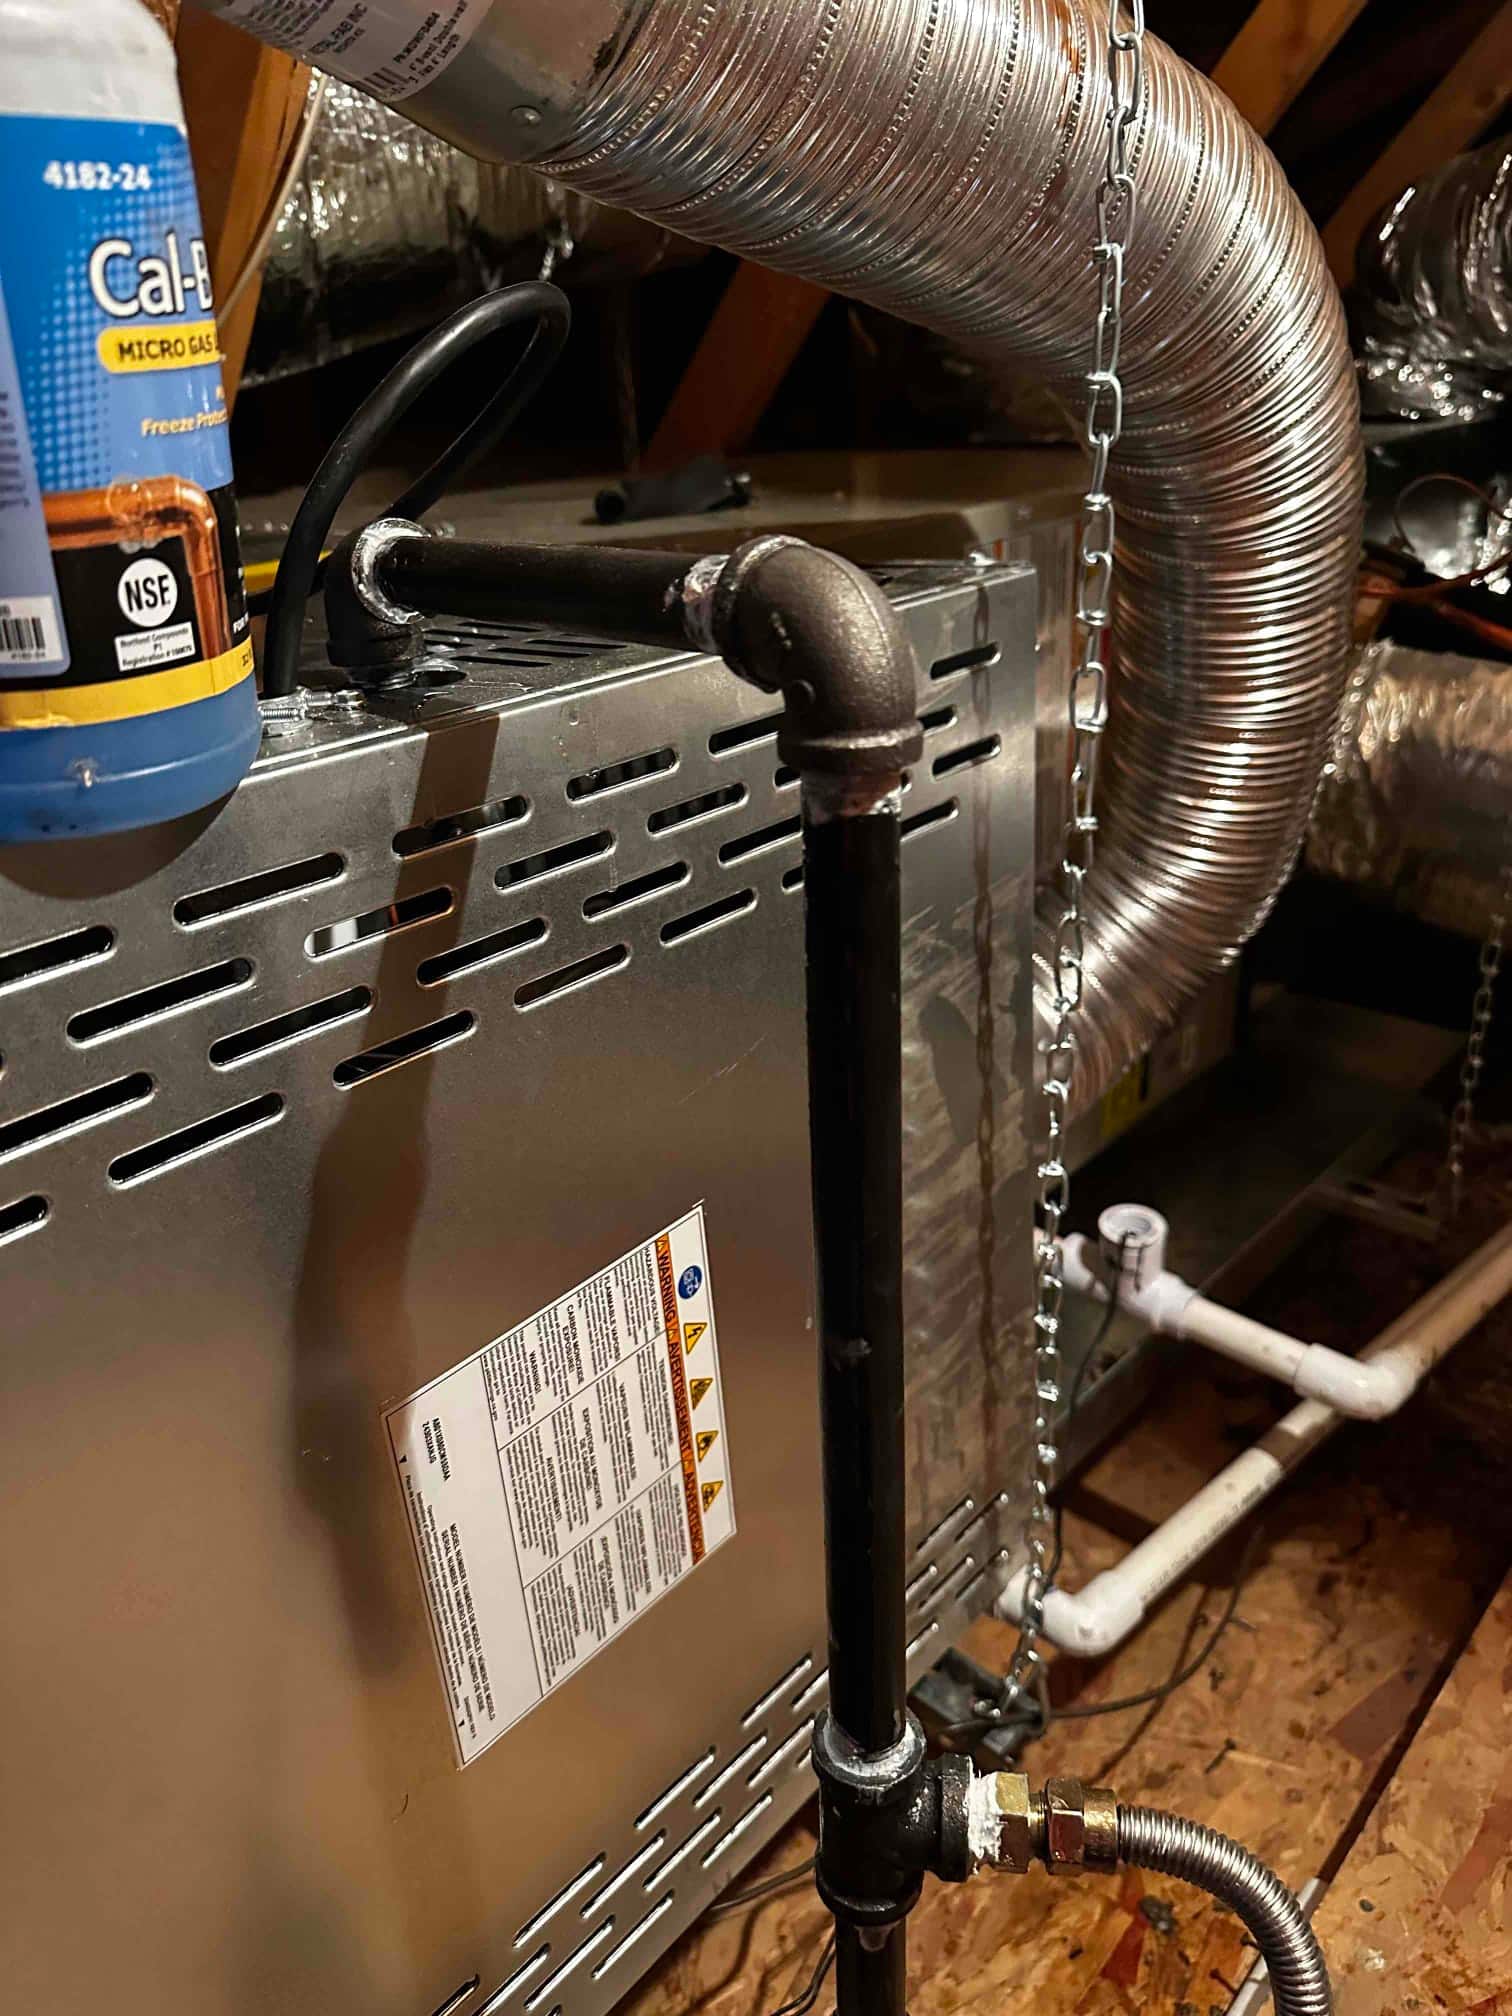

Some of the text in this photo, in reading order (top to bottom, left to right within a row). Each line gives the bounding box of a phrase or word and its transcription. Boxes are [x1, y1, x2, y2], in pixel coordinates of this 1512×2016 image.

[44, 160, 153, 192] 4182-24
[117, 334, 213, 362] MICRO GAS
[141, 417, 195, 437] Freeze
[124, 573, 169, 613] NSF
[603, 1274, 616, 1326] FLAMMABLE
[658, 1250, 675, 1324] WARNING
[562, 1324, 575, 1374] EXPOSURE!
[566, 1303, 584, 1384] CARBON MONOXIDE
[528, 1349, 542, 1394] WARNING!
[667, 1337, 691, 1456] AVERTISSEMENT
[683, 1468, 703, 1562] ADVERTENCIA
[439, 1528, 452, 1557] SERIAL
[448, 1522, 460, 1551] MODEL
[445, 1554, 458, 1587] NUMBER
[453, 1548, 466, 1581] NUMBER
[459, 1618, 468, 1632] DE
[467, 1612, 476, 1625] DE
